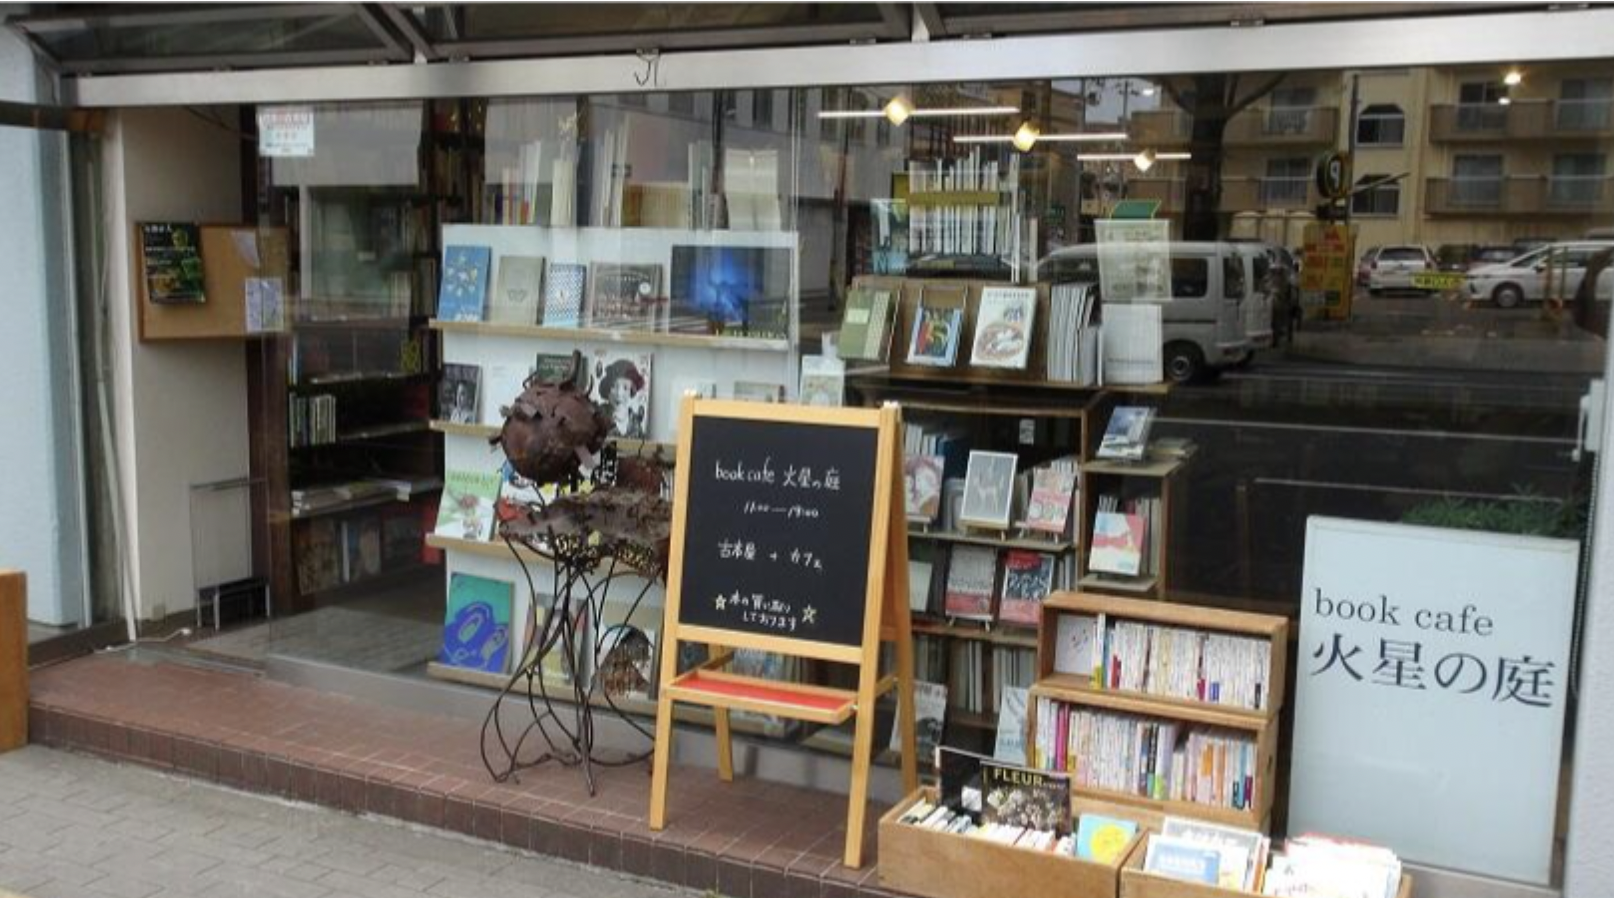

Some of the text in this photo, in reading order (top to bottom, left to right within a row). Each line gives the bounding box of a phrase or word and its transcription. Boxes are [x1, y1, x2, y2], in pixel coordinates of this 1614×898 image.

[782, 463, 840, 491] 火星の庭
[718, 538, 756, 561] 古本屋
[790, 547, 823, 572] カフェ
[1314, 588, 1494, 637] book cafe
[1310, 632, 1555, 708] 火星の庭
[994, 768, 1043, 787] FLEUR
